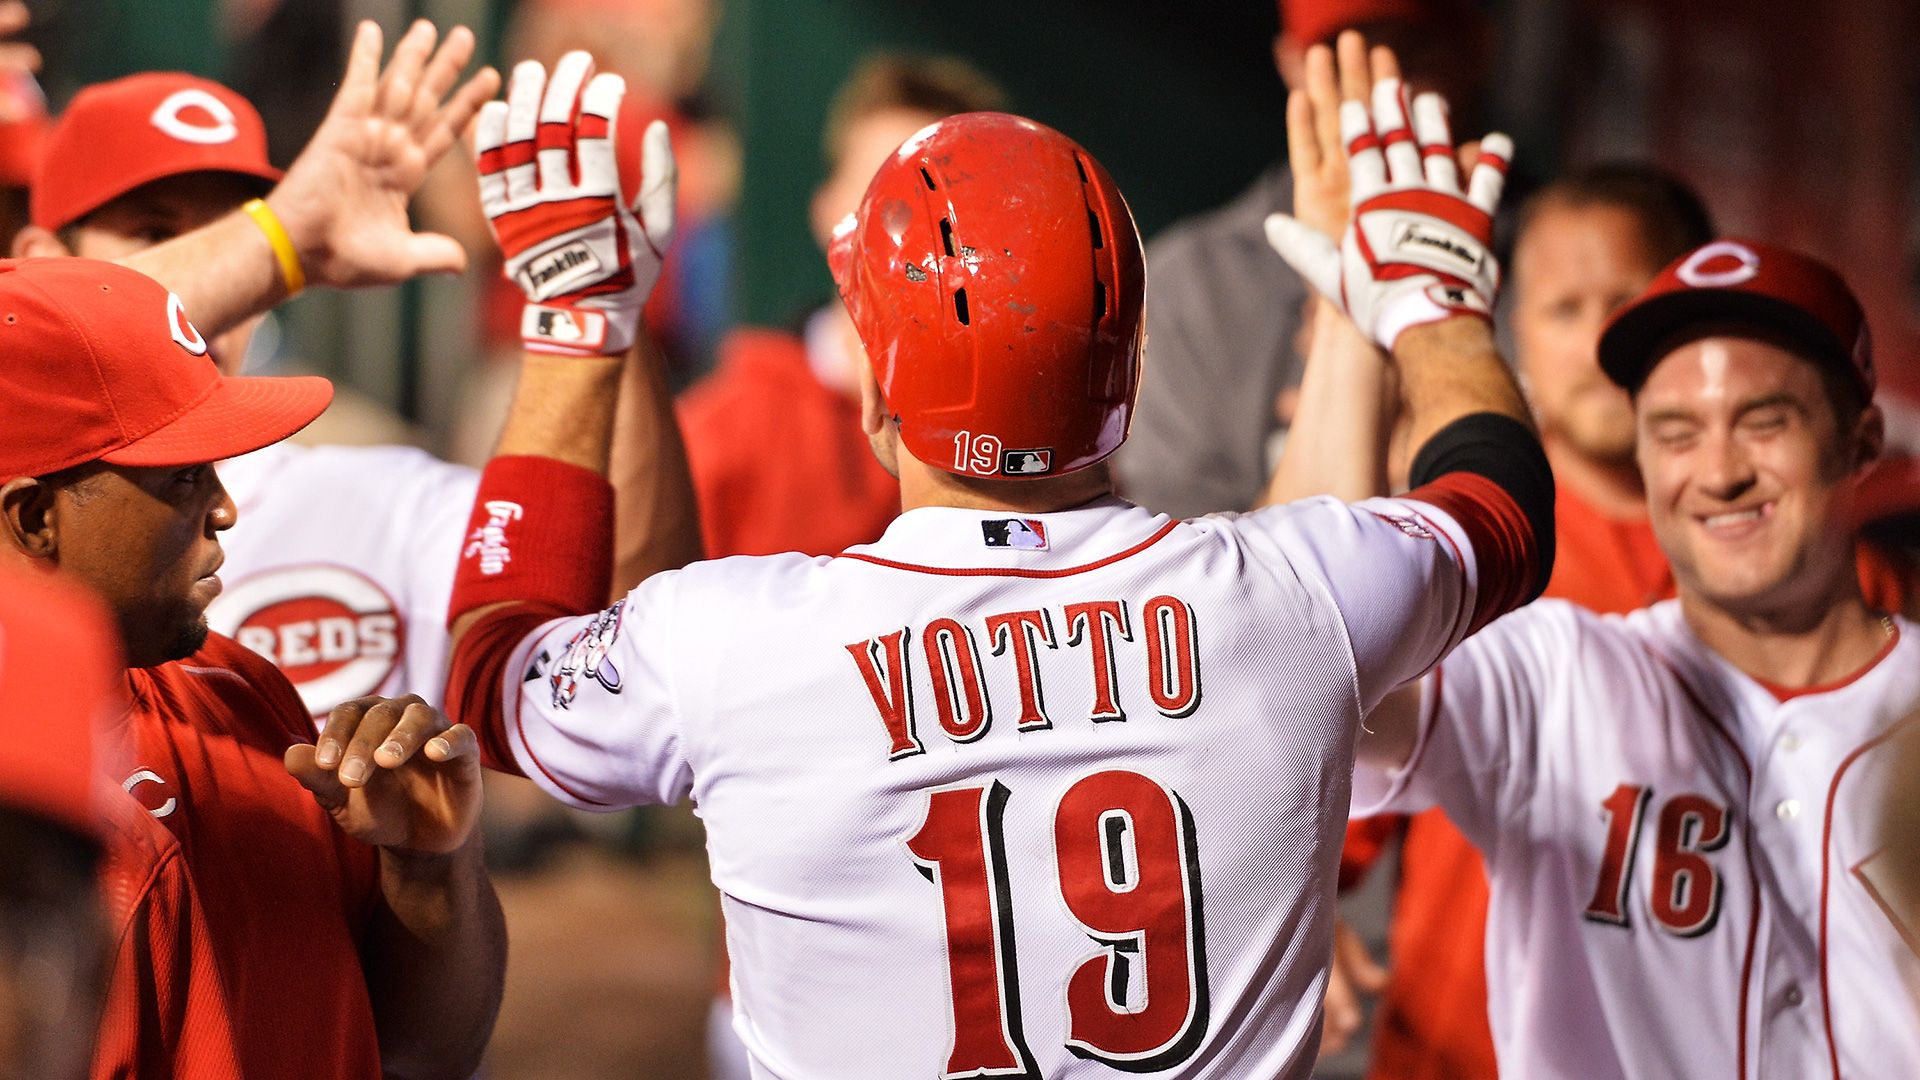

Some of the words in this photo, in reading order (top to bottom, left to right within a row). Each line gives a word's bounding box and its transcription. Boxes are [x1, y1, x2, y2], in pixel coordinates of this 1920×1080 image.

[954, 430, 1002, 475] 19
[238, 614, 398, 668] REDS
[844, 594, 1203, 762] VOTTO
[896, 766, 1210, 1080] 19
[1582, 784, 1733, 938] 16
